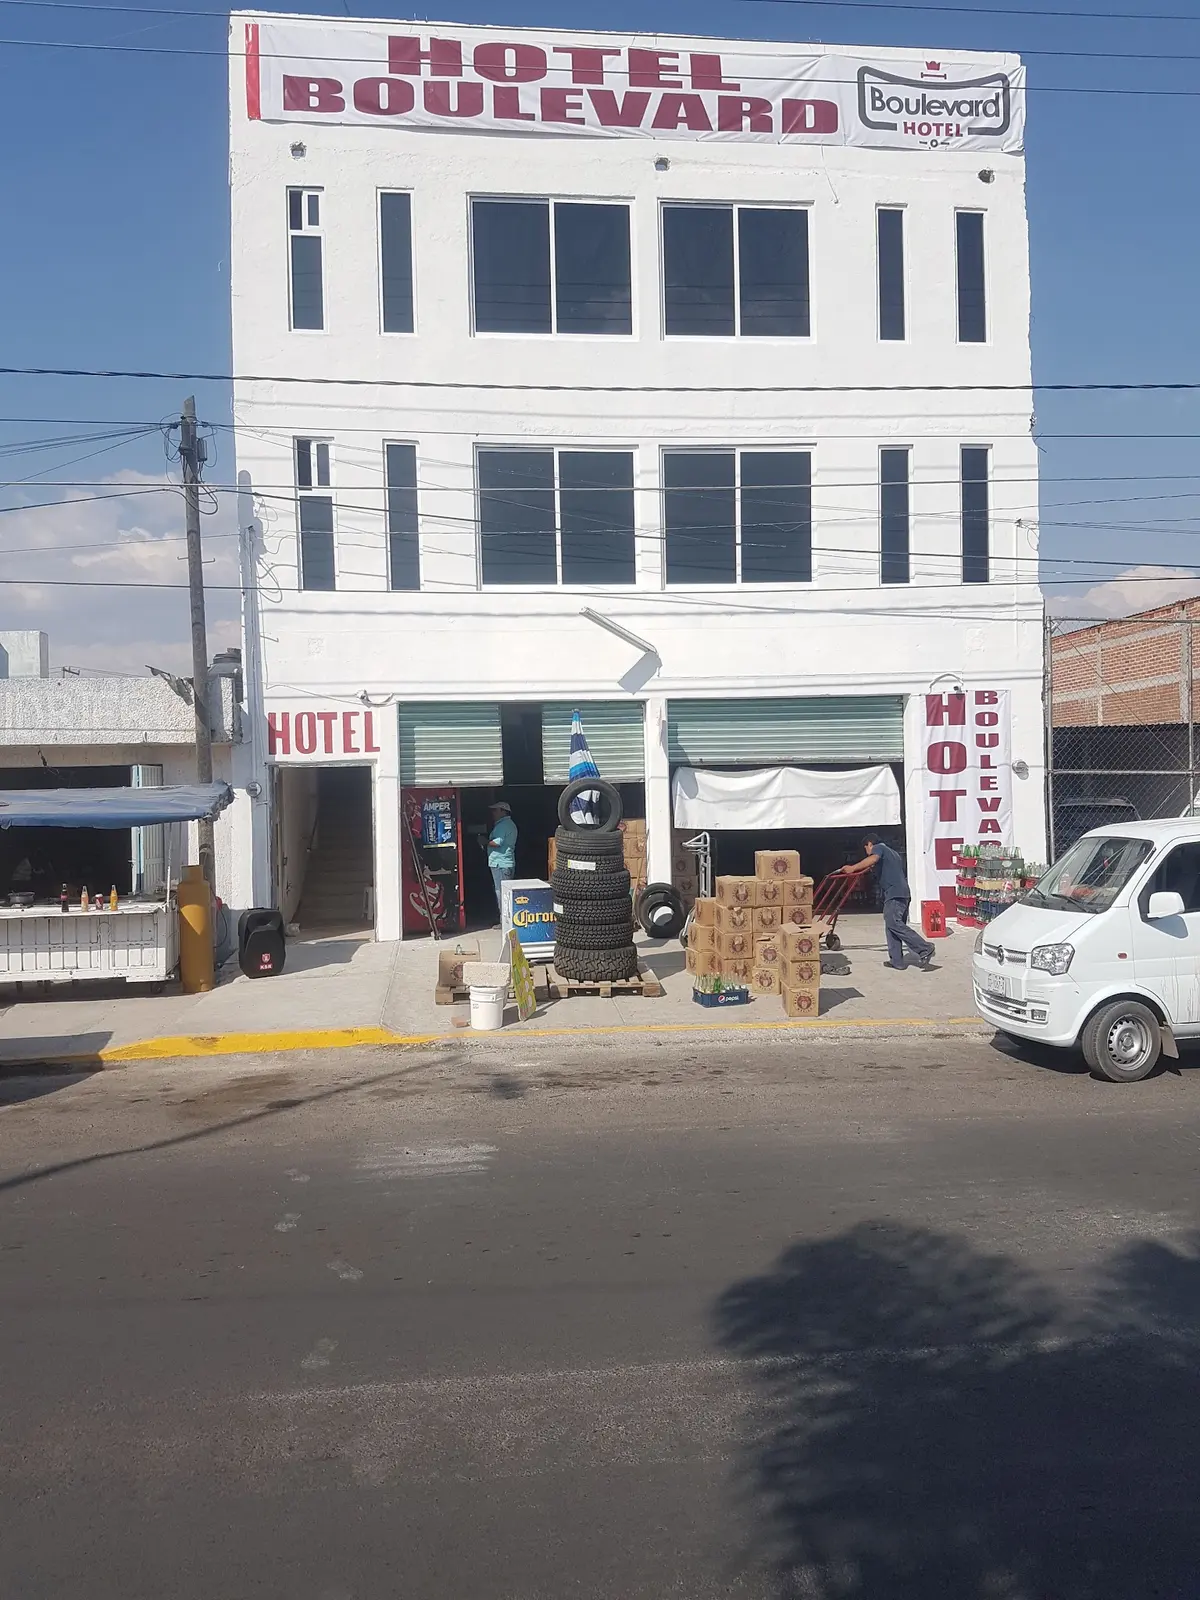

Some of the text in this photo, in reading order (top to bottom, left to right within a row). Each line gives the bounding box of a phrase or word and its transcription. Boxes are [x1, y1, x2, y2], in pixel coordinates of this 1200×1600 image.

[388, 35, 741, 92] HOTEL
[283, 74, 839, 134] BOULEVARD
[871, 86, 1000, 118] Boulevard
[903, 121, 963, 138] HOTEL
[268, 711, 380, 755] HOTEL
[975, 690, 1002, 847] BOULEVA
[423, 801, 451, 811] AMPER
[513, 909, 557, 927] Coron
